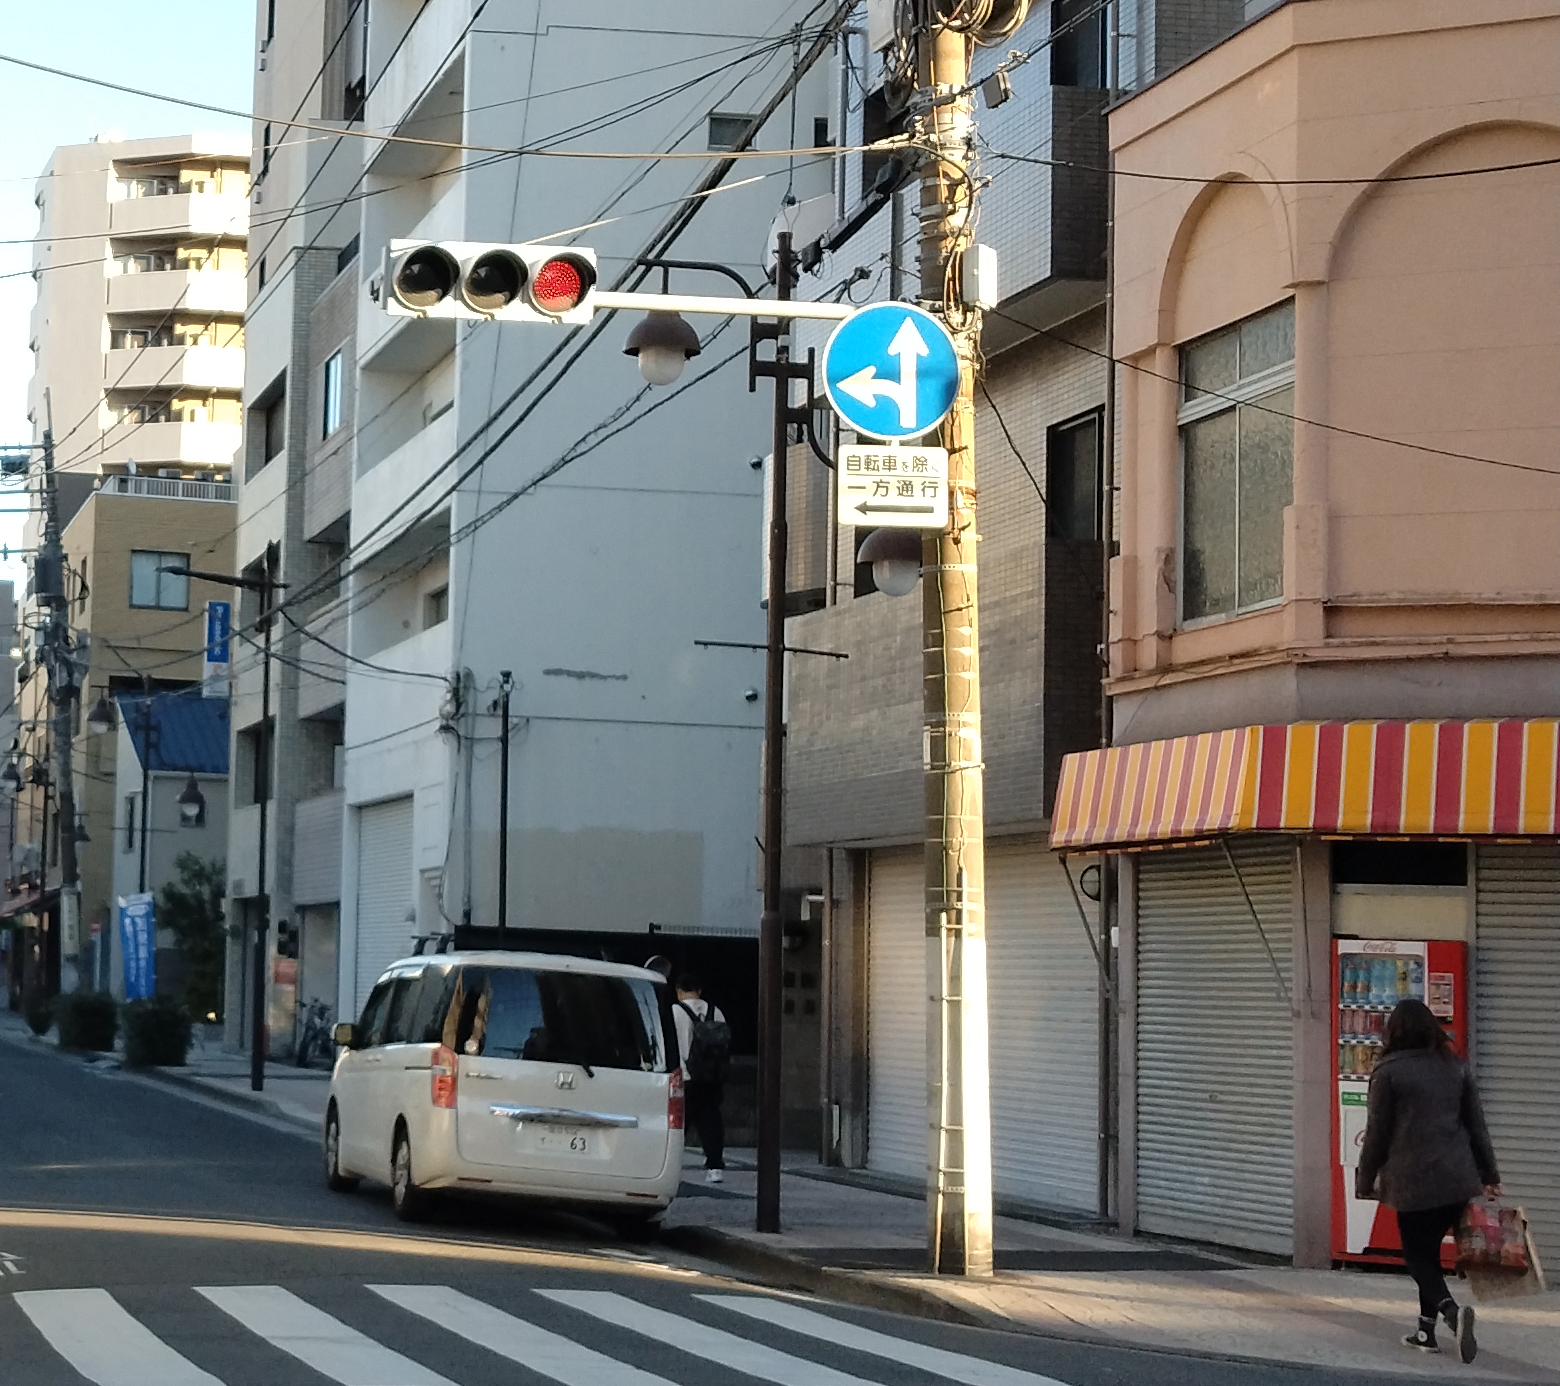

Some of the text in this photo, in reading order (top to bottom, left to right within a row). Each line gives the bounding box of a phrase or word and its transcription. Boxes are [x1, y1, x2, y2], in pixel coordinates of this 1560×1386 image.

[846, 454, 939, 473] 自転車を除く
[847, 479, 939, 498] 一方通行
[214, 605, 224, 655] Paasoic
